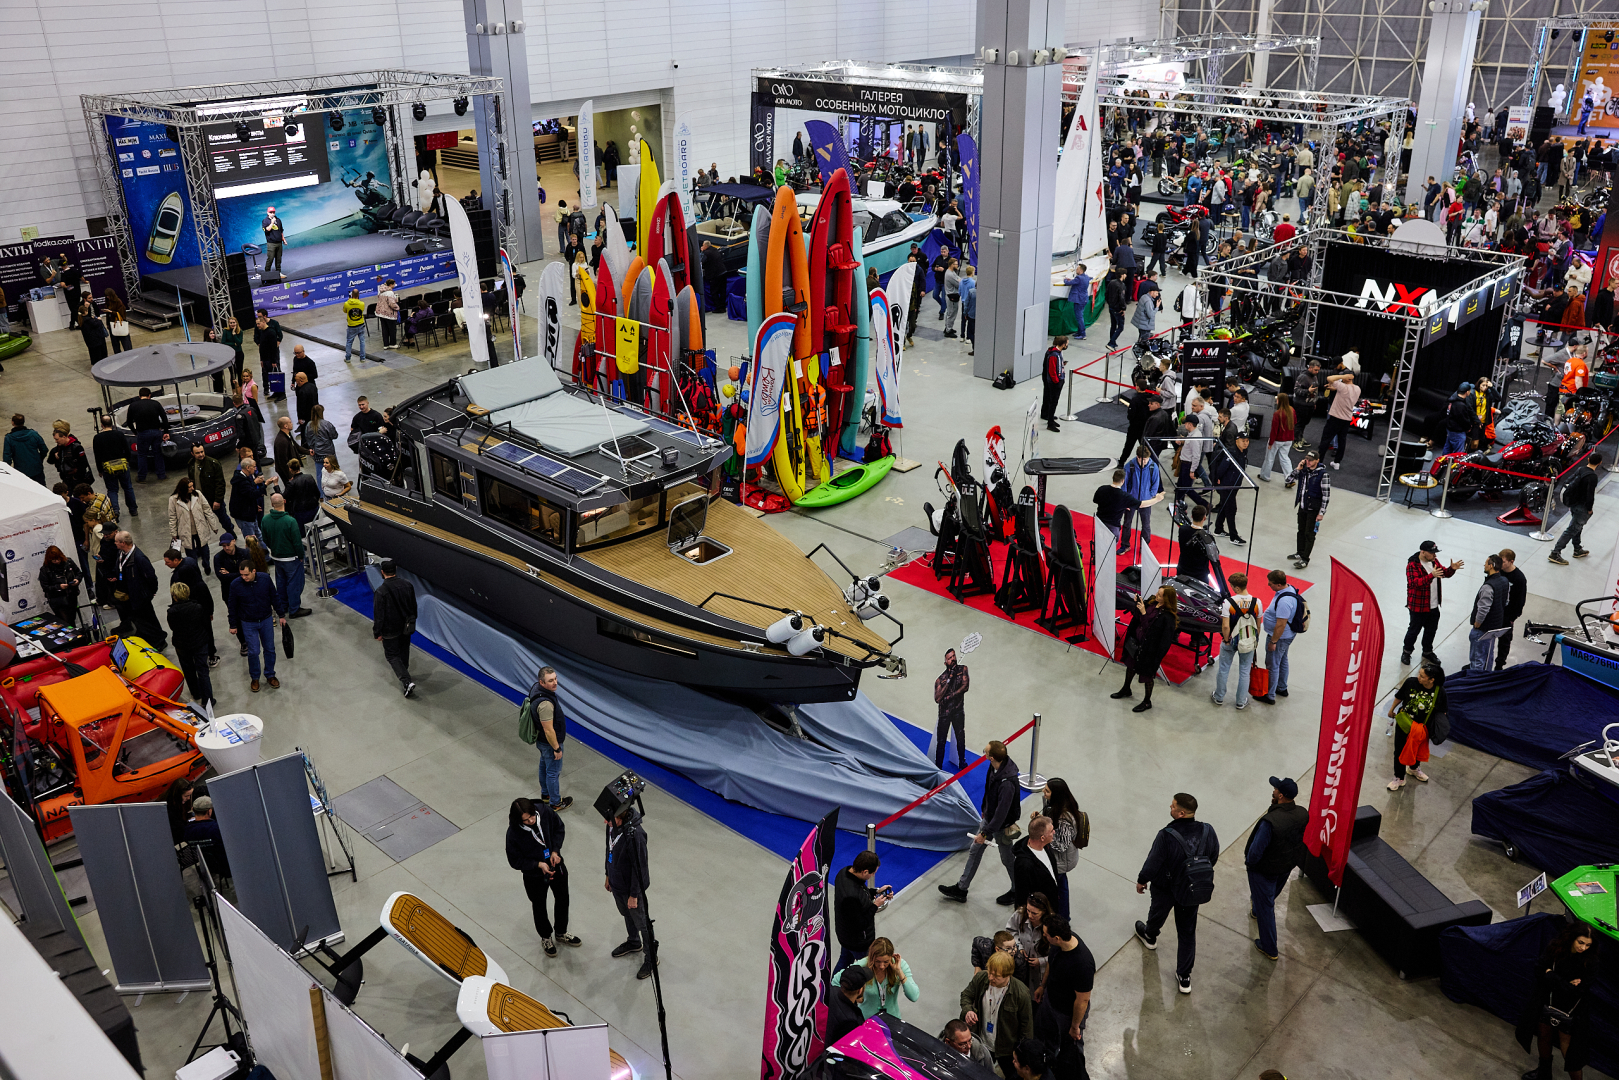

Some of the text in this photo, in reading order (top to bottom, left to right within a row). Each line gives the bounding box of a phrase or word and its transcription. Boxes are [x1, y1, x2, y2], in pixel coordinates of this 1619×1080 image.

[861, 89, 903, 104] ГАЛЕРЕЯ
[815, 98, 876, 114] ОСОБЕННЫХ
[680, 139, 689, 196] JETBOARD
[77, 237, 115, 253] ЯХТЫ
[1366, 311, 1397, 321] NIKOLA
[1191, 347, 1219, 357] NXM
